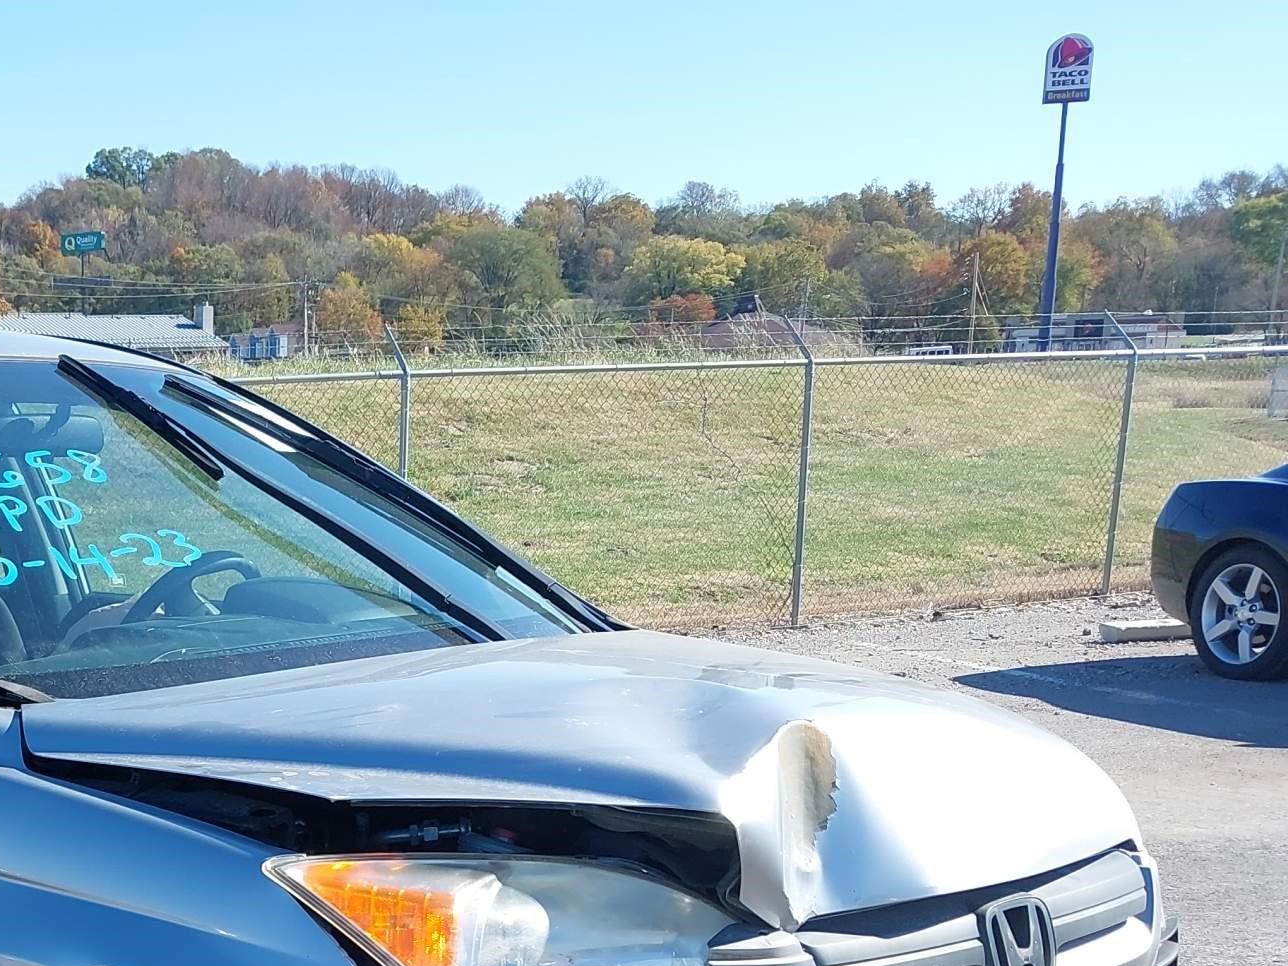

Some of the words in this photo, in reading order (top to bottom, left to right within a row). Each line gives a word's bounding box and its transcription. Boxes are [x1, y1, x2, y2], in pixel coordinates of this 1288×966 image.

[1049, 69, 1089, 79] TACO
[1051, 77, 1089, 87] BELL
[76, 234, 98, 246] Quality
